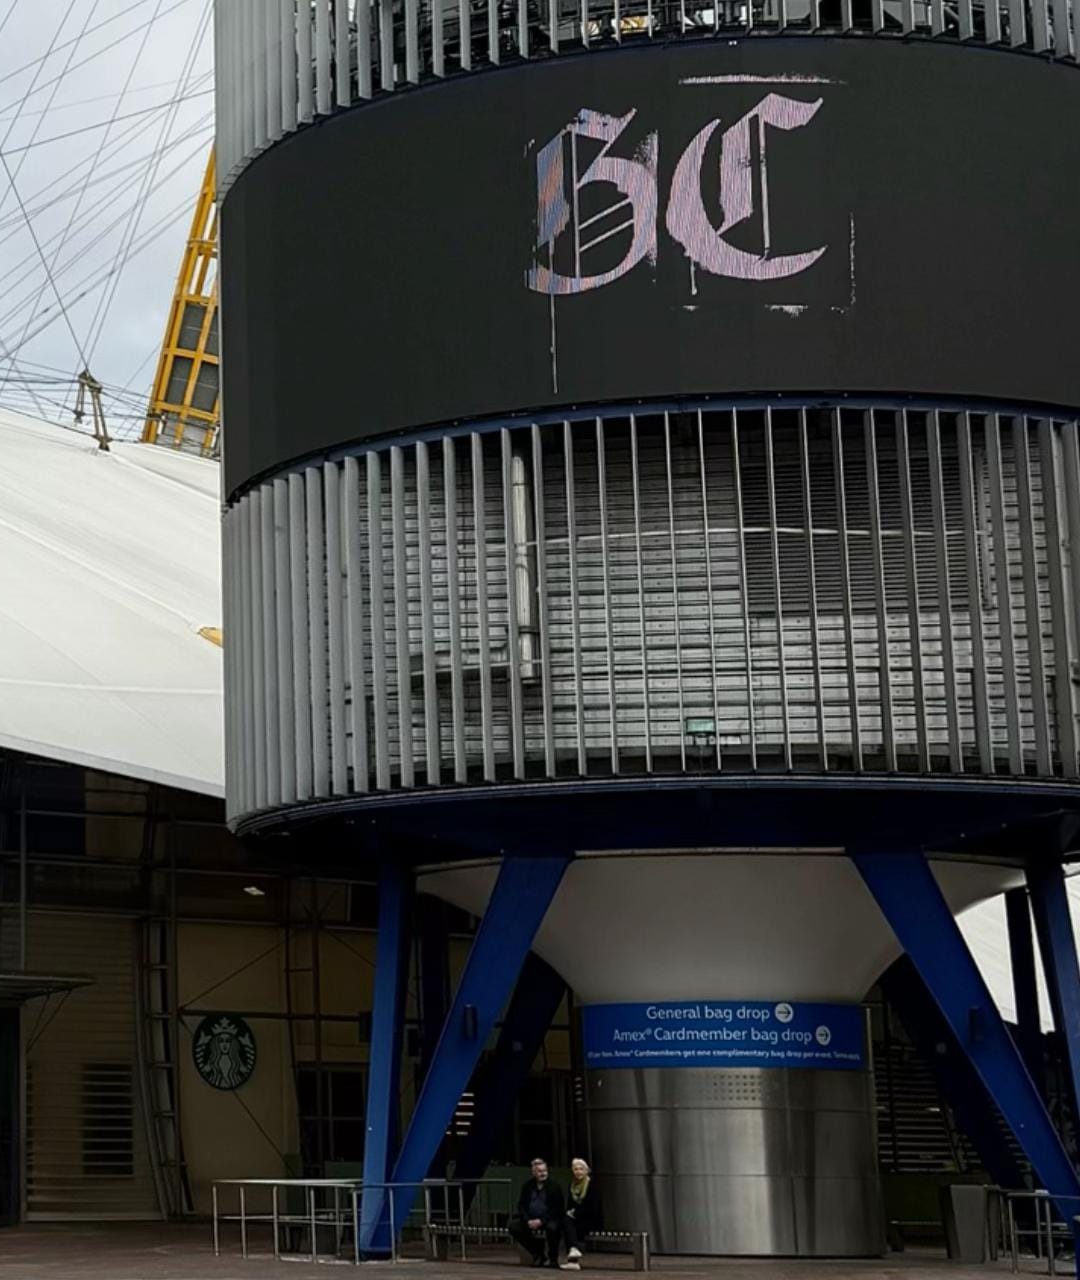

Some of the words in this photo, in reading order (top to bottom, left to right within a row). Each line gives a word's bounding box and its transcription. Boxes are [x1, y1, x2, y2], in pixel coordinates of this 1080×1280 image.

[646, 1005, 701, 1020] General
[704, 1005, 733, 1023] bag
[736, 1005, 770, 1023] drop
[653, 1026, 748, 1041] Cardmember
[750, 1027, 778, 1045] bag
[781, 1027, 813, 1045] drop
